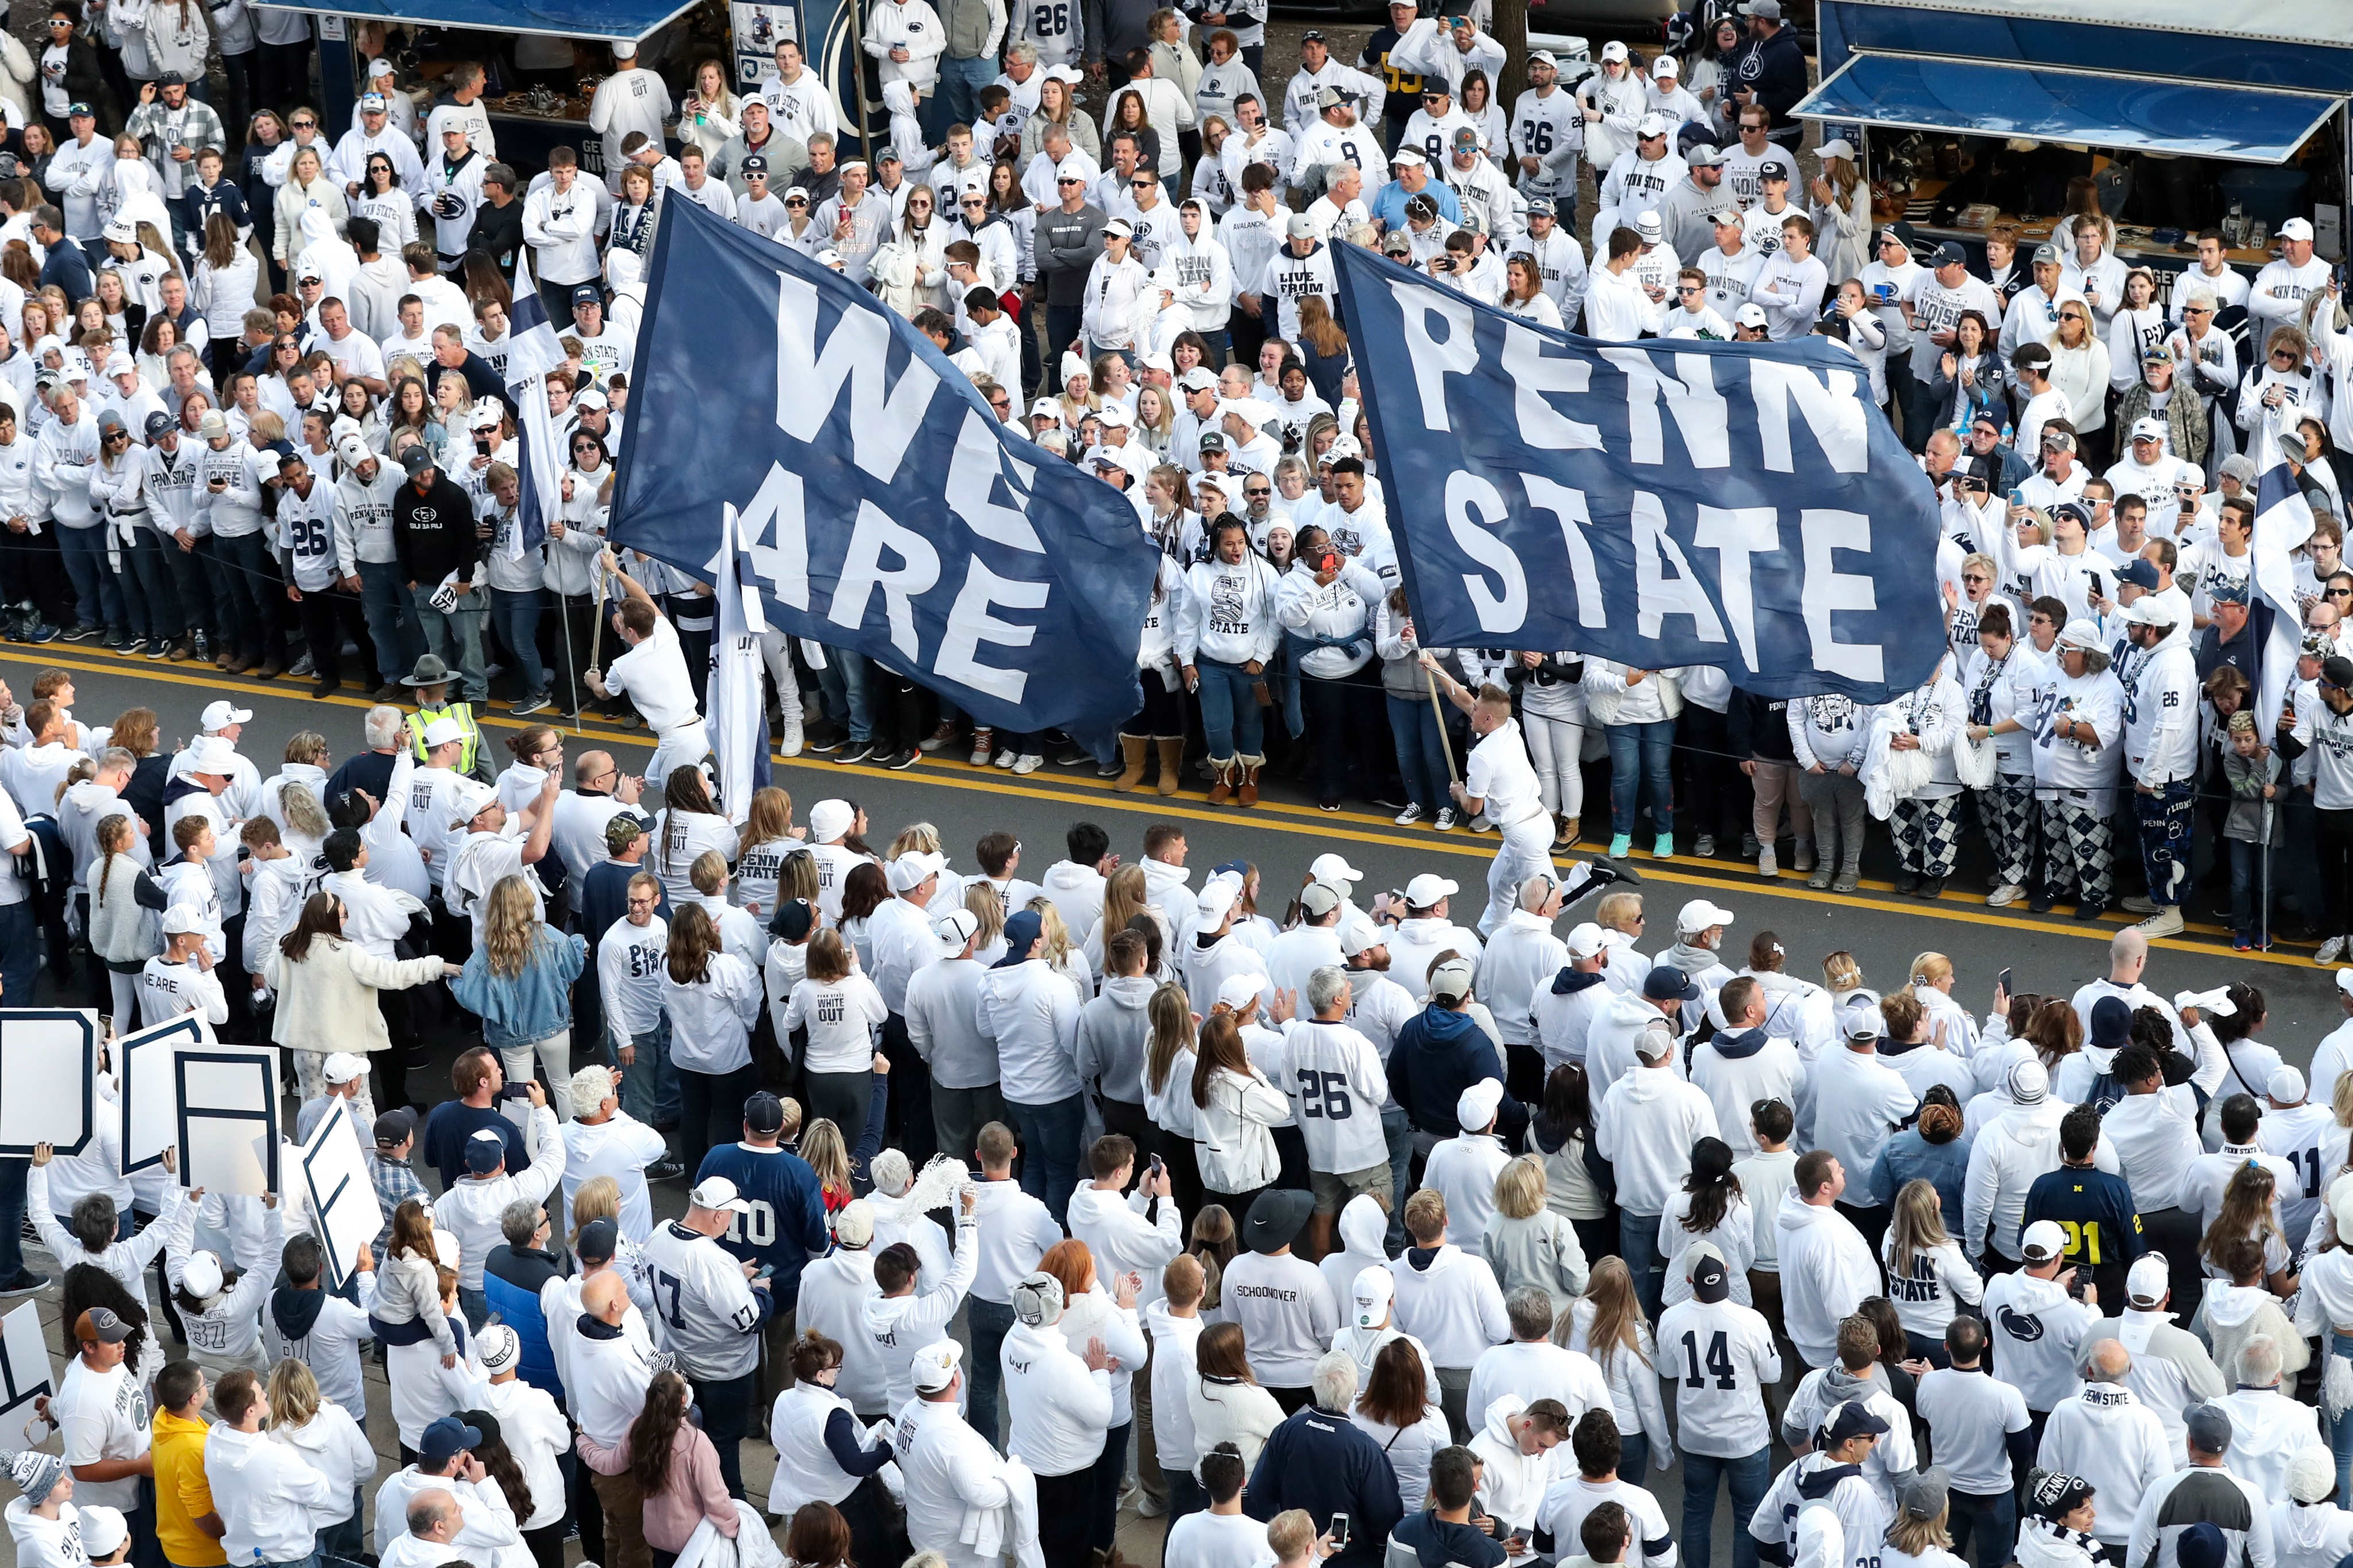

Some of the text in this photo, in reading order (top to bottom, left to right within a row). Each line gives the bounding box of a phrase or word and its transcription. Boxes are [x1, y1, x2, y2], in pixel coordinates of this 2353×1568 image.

[1035, 3, 1068, 37] 26
[1523, 119, 1553, 155] 26
[583, 140, 603, 153] GE
[1425, 134, 1442, 158] 8
[1341, 141, 1361, 171] 8
[1624, 173, 1665, 192] PENN STATE
[1731, 179, 1764, 196] NOIS
[1468, 184, 1490, 203] STATE
[1691, 202, 1730, 217] PENN STATE
[110, 220, 132, 231] STATE
[1751, 227, 1768, 245] ENN
[839, 242, 871, 254] ANKFURT
[1175, 256, 1212, 271] PENN
[1280, 272, 1314, 283] LIVE
[1705, 276, 1722, 288] ENN
[1282, 283, 1323, 296] FROM
[1918, 298, 1962, 327] NOISE
[596, 346, 619, 363] STATE
[1386, 279, 1868, 473] PENN
[1991, 369, 2004, 380] 23
[773, 270, 1048, 555] WE
[152, 470, 195, 487] PENN STATE
[350, 509, 374, 520] PENN
[291, 519, 329, 557] 26
[703, 459, 1050, 705] ARE
[1445, 470, 1884, 682] STATE
[1954, 608, 1978, 627] PEN
[1209, 620, 1248, 635] STATE
[1953, 624, 1980, 645] TAT
[1769, 701, 1787, 712] PENN
[2163, 690, 2179, 708] 26
[226, 714, 233, 722] S
[414, 784, 433, 795] WHITE
[412, 794, 431, 810] OUT
[2171, 799, 2193, 813] LIONS
[2143, 819, 2166, 828] PENN
[741, 855, 780, 868] PENN
[817, 863, 834, 872] HITE
[738, 866, 780, 880] STATE
[819, 872, 833, 887] UT
[155, 976, 179, 994] ARE
[817, 998, 844, 1009] WHITE
[818, 1008, 844, 1022] OUT
[1296, 1068, 1352, 1121] 26
[175, 1051, 279, 1194] A
[2224, 1145, 2256, 1154] PENN STATE
[1237, 1284, 1297, 1303] SCHOONOVER
[1889, 1275, 1940, 1302] STATE
[645, 1264, 689, 1333] 17
[732, 1304, 754, 1331] 17
[185, 1317, 226, 1348] 87
[502, 1325, 512, 1348] PENN
[485, 1350, 508, 1365] STATE
[1681, 1330, 1736, 1390] 14
[2081, 1389, 2130, 1407] PENN STATE
[900, 1418, 916, 1435] WHITE
[897, 1429, 913, 1454] OUT
